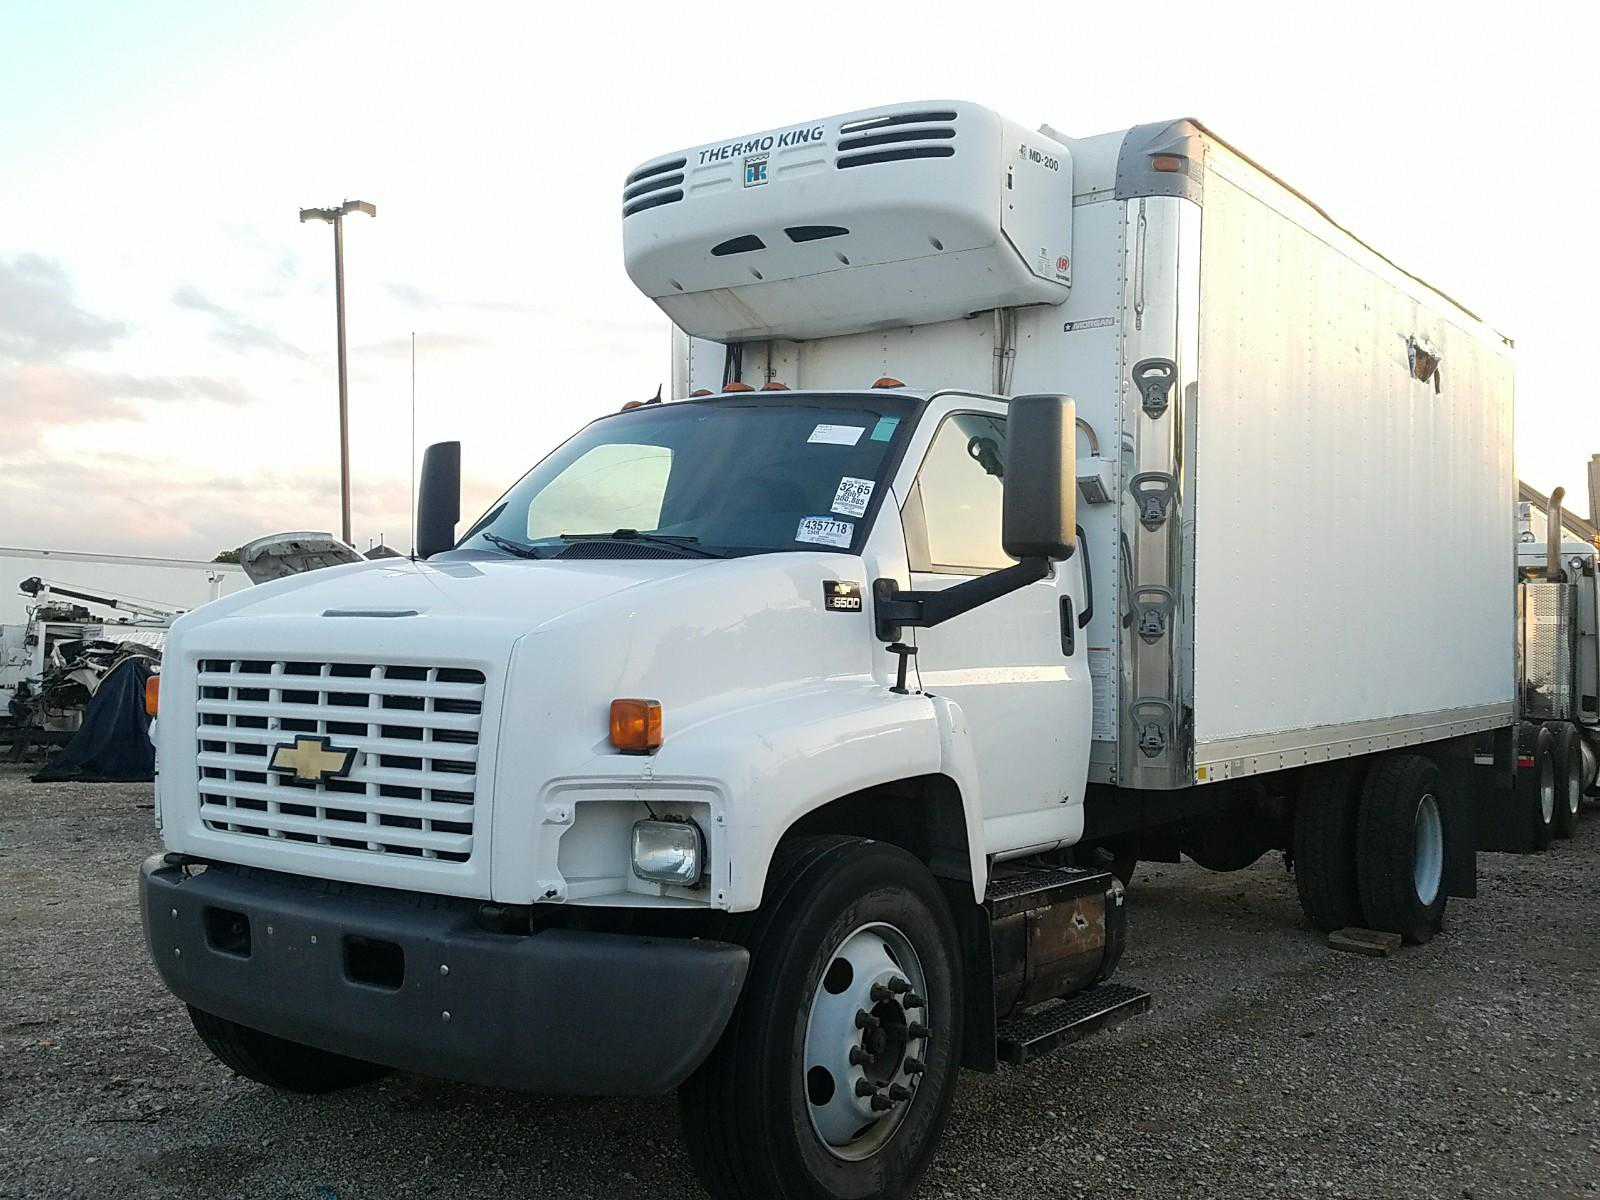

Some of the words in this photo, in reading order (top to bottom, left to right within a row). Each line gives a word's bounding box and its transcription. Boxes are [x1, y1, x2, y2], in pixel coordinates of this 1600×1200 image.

[699, 136, 774, 165] THERMO
[777, 126, 824, 148] KING
[1029, 148, 1059, 172] MD-200
[804, 520, 848, 535] 4357718
